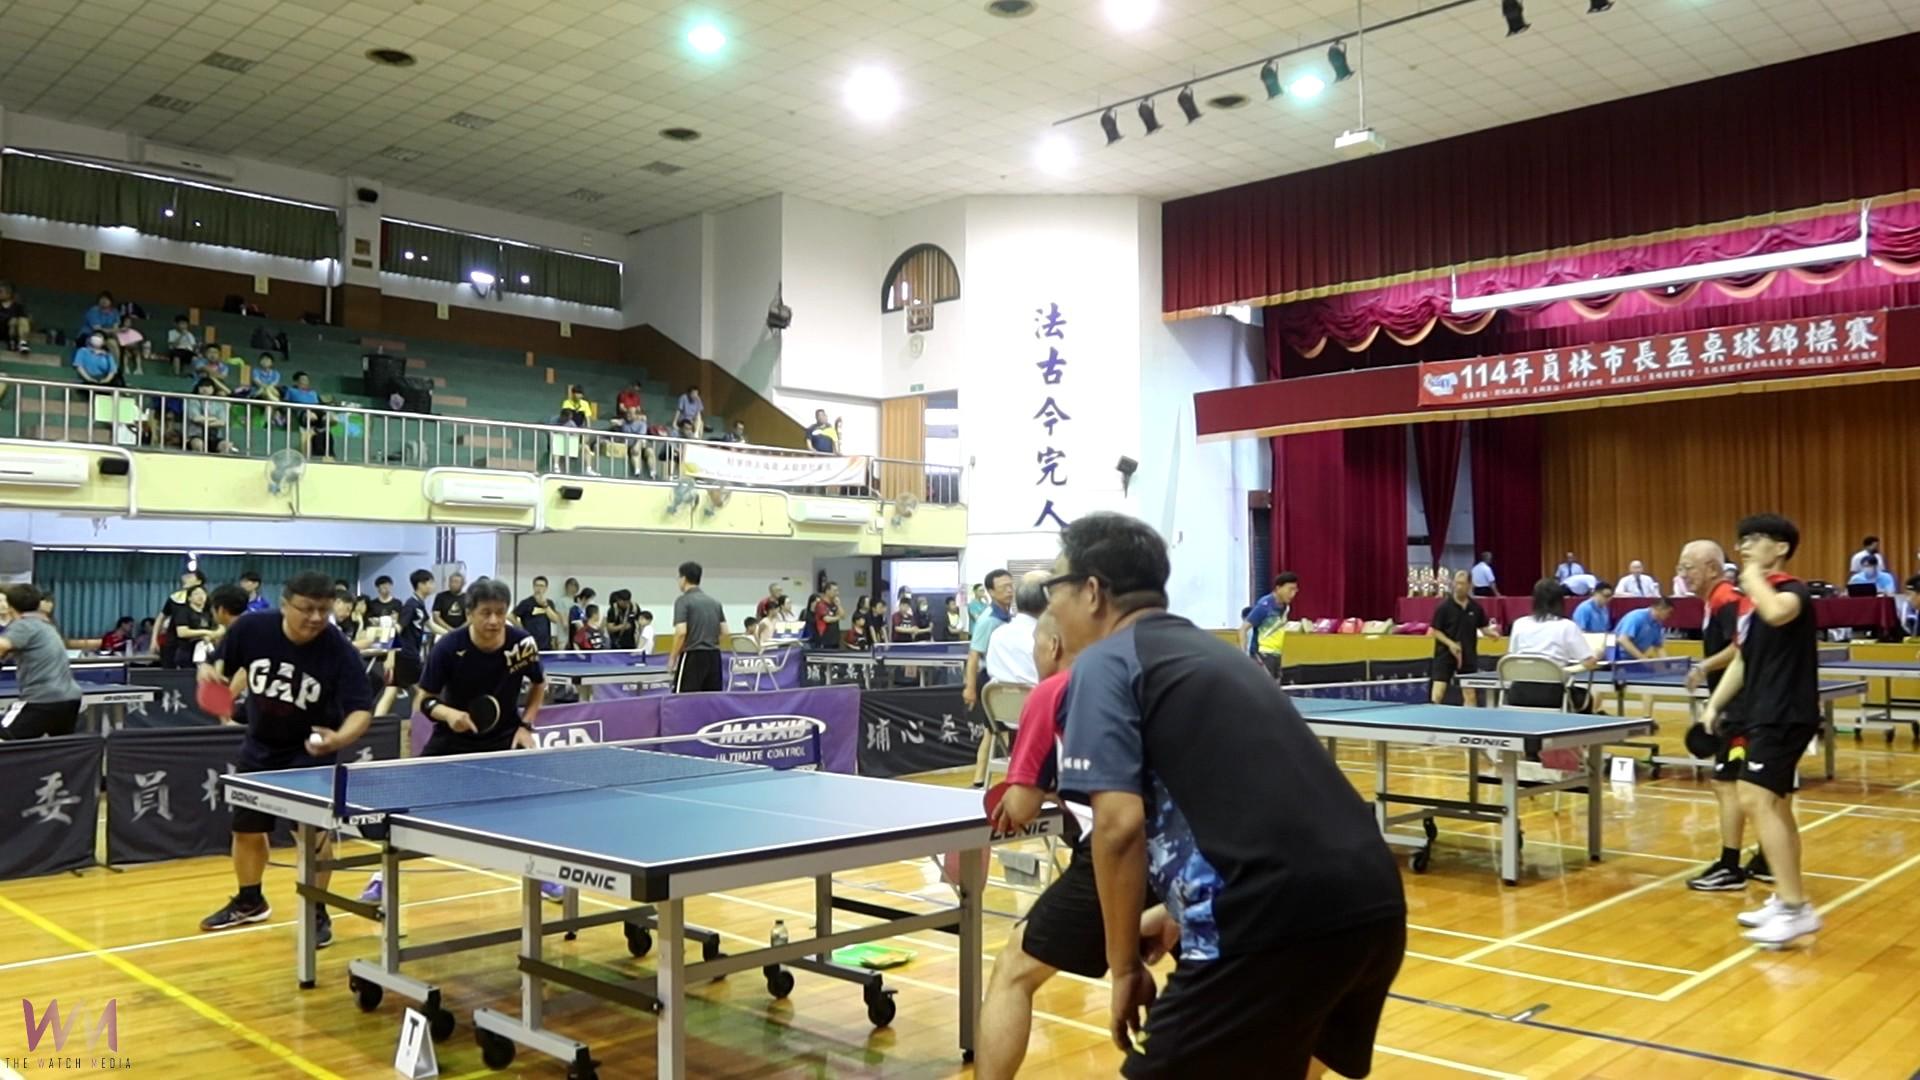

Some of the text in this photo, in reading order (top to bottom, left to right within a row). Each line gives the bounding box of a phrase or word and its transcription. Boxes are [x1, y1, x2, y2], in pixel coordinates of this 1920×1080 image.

[1460, 316, 1879, 389] 114年員林市長盃桌球錦標賽
[1033, 301, 1071, 528] 法古今完人
[248, 657, 322, 711] GAP
[767, 746, 805, 759] CONTROL
[1459, 736, 1511, 747] DONIC
[1617, 760, 1628, 771] T
[558, 866, 617, 891] DONIC
